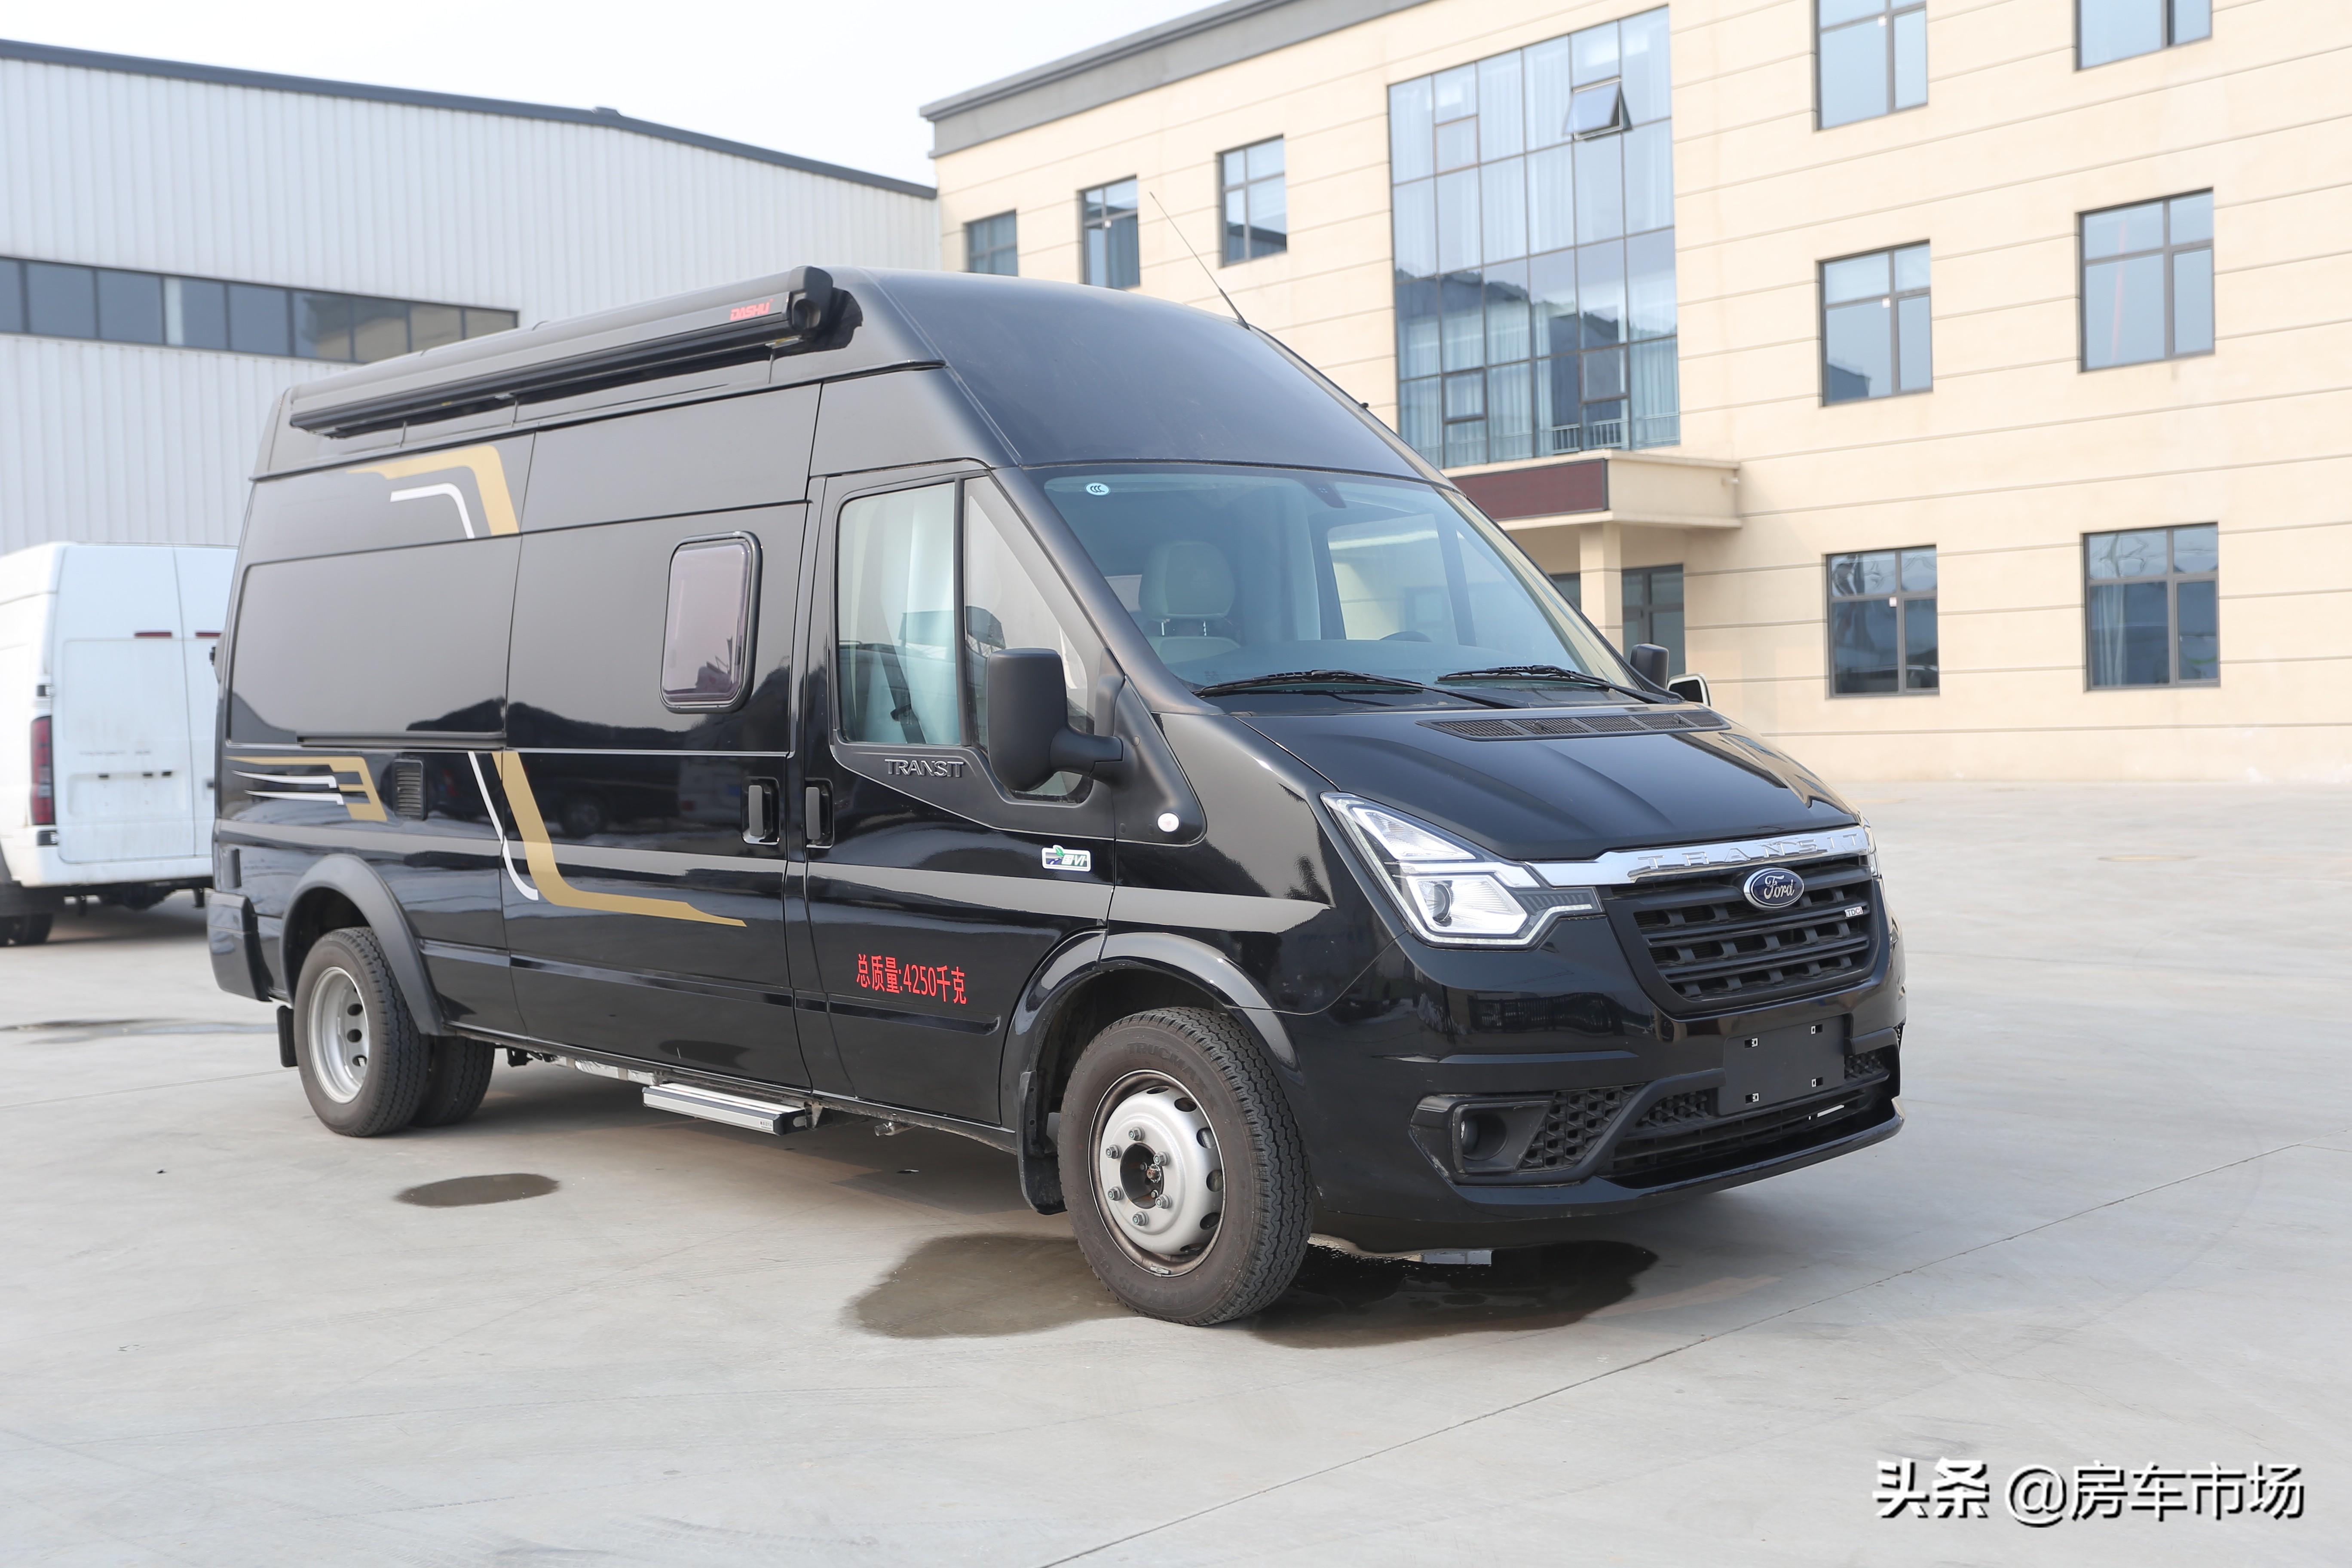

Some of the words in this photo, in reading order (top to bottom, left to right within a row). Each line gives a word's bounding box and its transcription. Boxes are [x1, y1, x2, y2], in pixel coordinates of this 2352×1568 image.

[729, 302, 770, 321] DASHU
[884, 759, 964, 777] TRANSIT
[1638, 833, 1859, 870] TRANSIT
[1764, 875, 1795, 900] Ford
[1846, 907, 1862, 916] TDCi
[856, 953, 967, 1004] 总质量:4250千克
